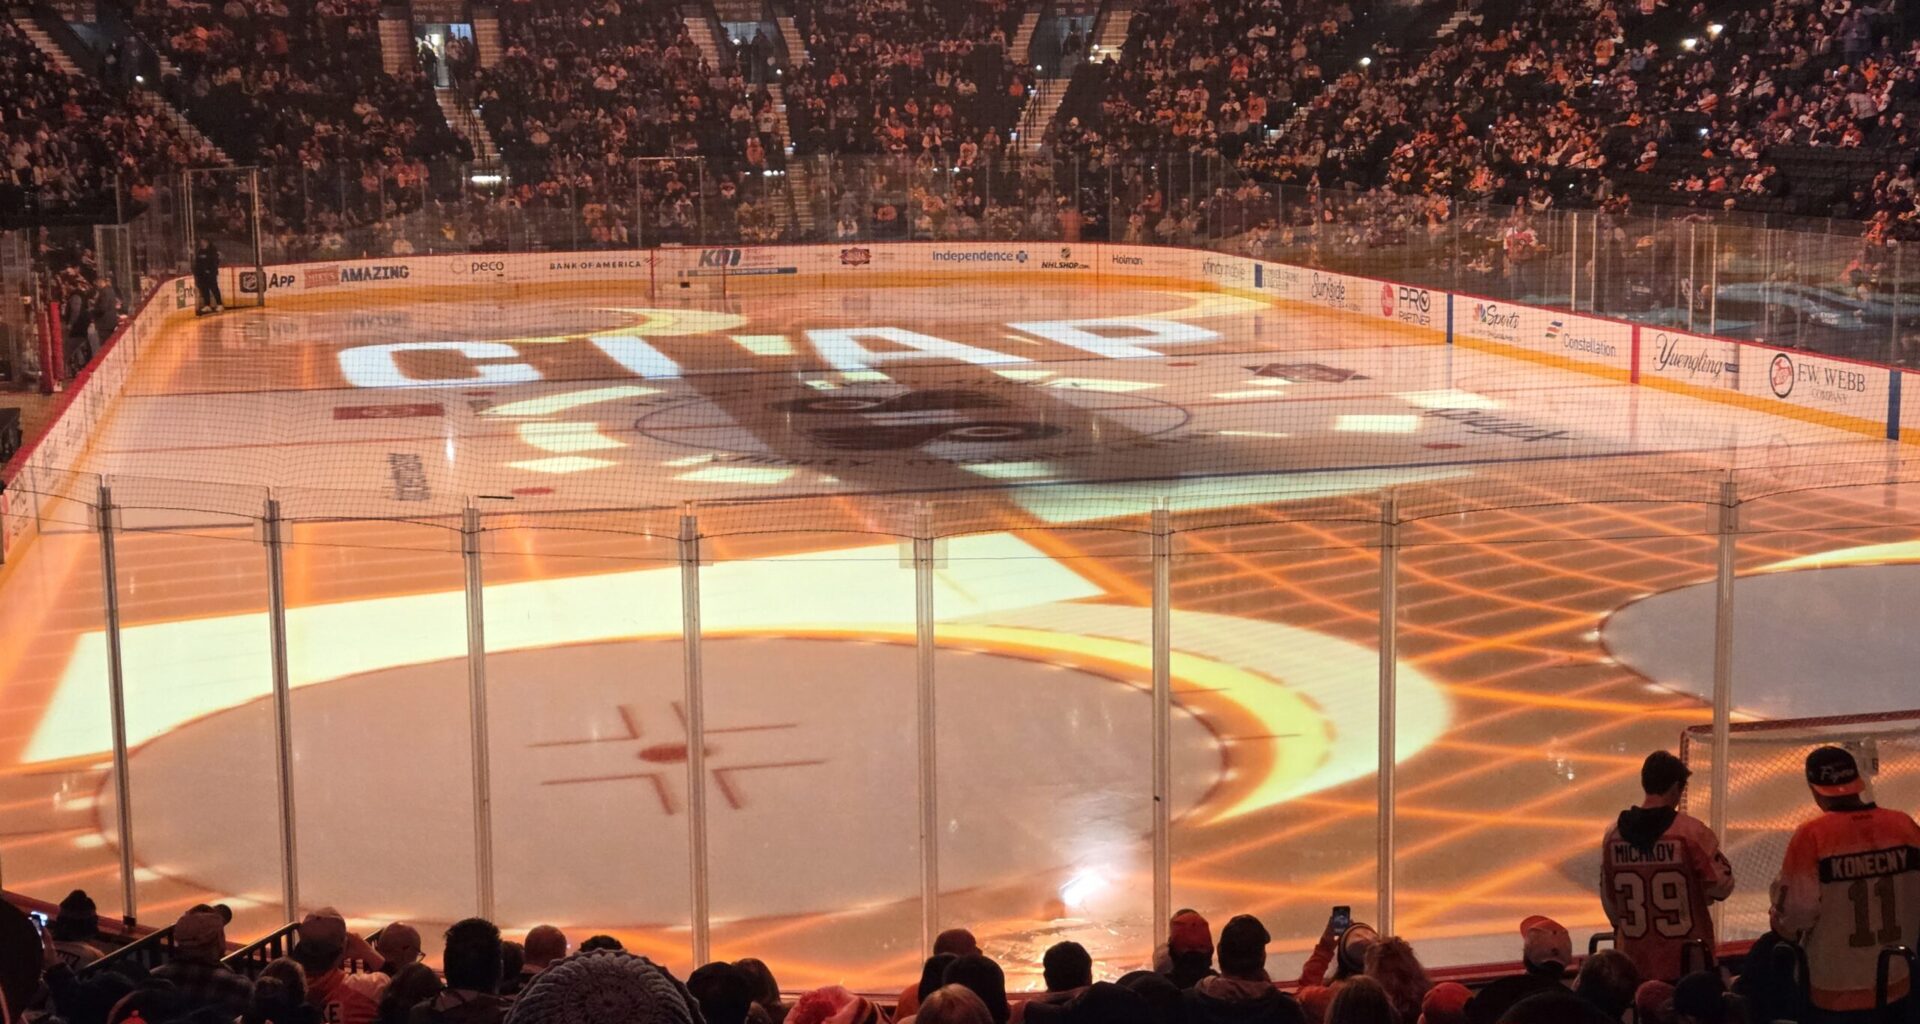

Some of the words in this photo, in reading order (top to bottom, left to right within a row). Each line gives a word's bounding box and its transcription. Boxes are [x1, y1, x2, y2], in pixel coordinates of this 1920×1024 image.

[471, 259, 504, 274] peco
[550, 261, 577, 270] BANK
[581, 261, 594, 269] OF
[595, 260, 641, 269] AMERICA
[932, 251, 1013, 263] Independence
[1112, 253, 1142, 265] Holman
[341, 265, 409, 282] AMAZING
[1487, 304, 1520, 329] Sports
[1563, 332, 1617, 358] Constellation
[1653, 333, 1723, 381] Yuengling
[1823, 367, 1866, 393] WEBB
[1830, 847, 1909, 879] KONECNY
[1613, 870, 1694, 938] 39
[1848, 874, 1903, 948] 11
